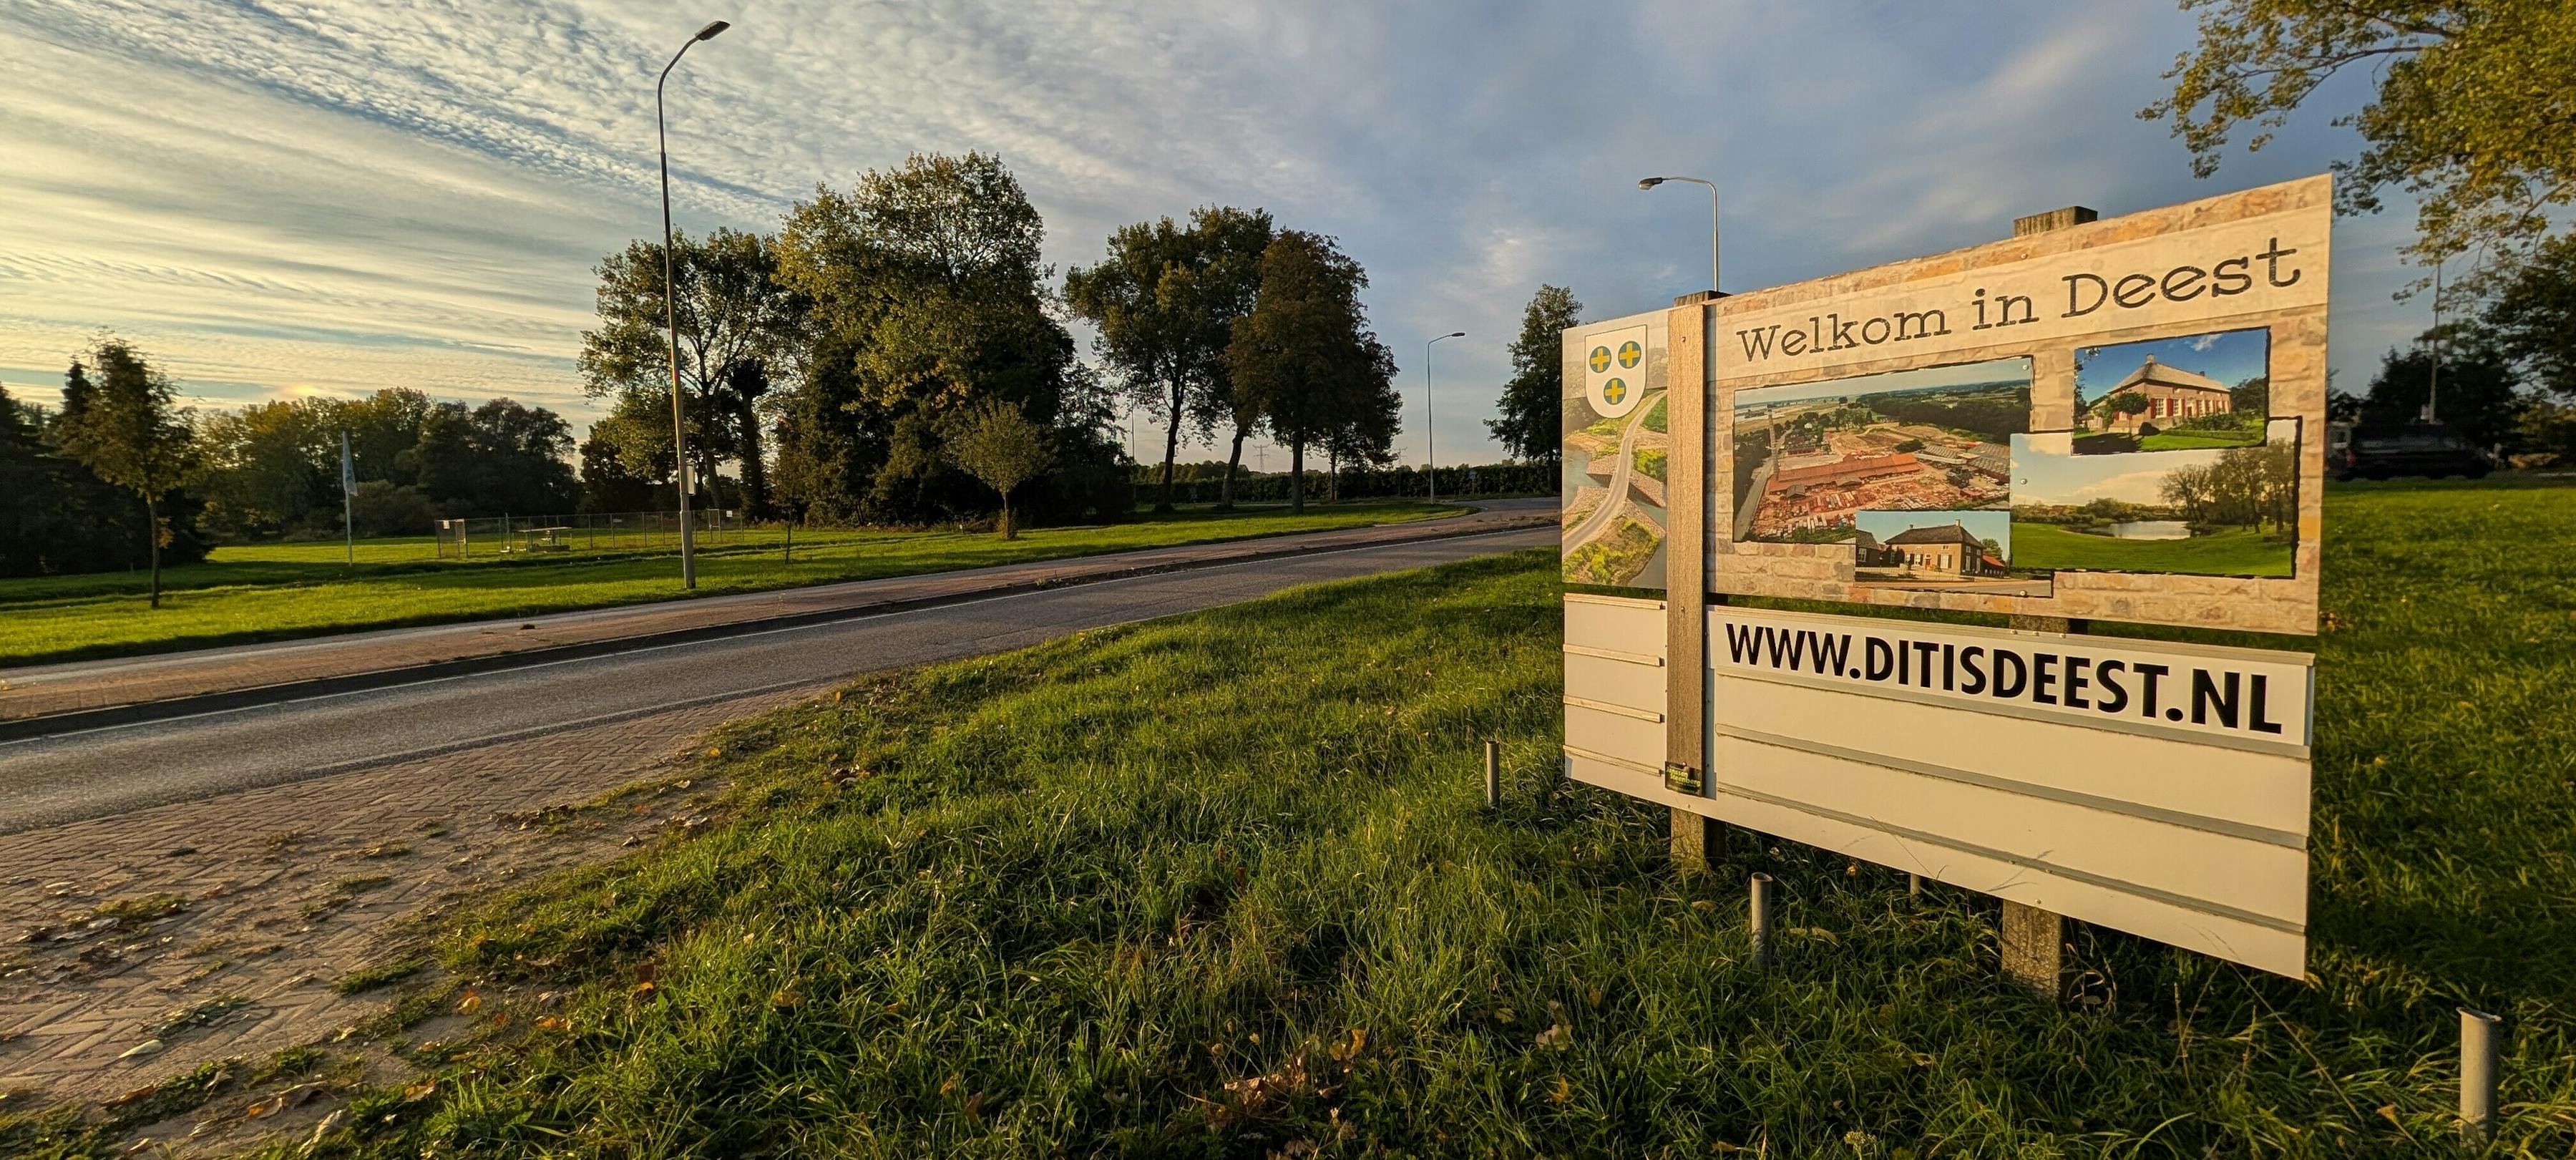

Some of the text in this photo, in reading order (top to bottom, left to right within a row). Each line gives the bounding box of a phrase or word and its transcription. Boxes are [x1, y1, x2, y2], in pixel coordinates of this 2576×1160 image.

[1736, 237, 2301, 362] Welkom in Deest
[1724, 623, 2283, 734] WWW.DITISDEEST.NL
